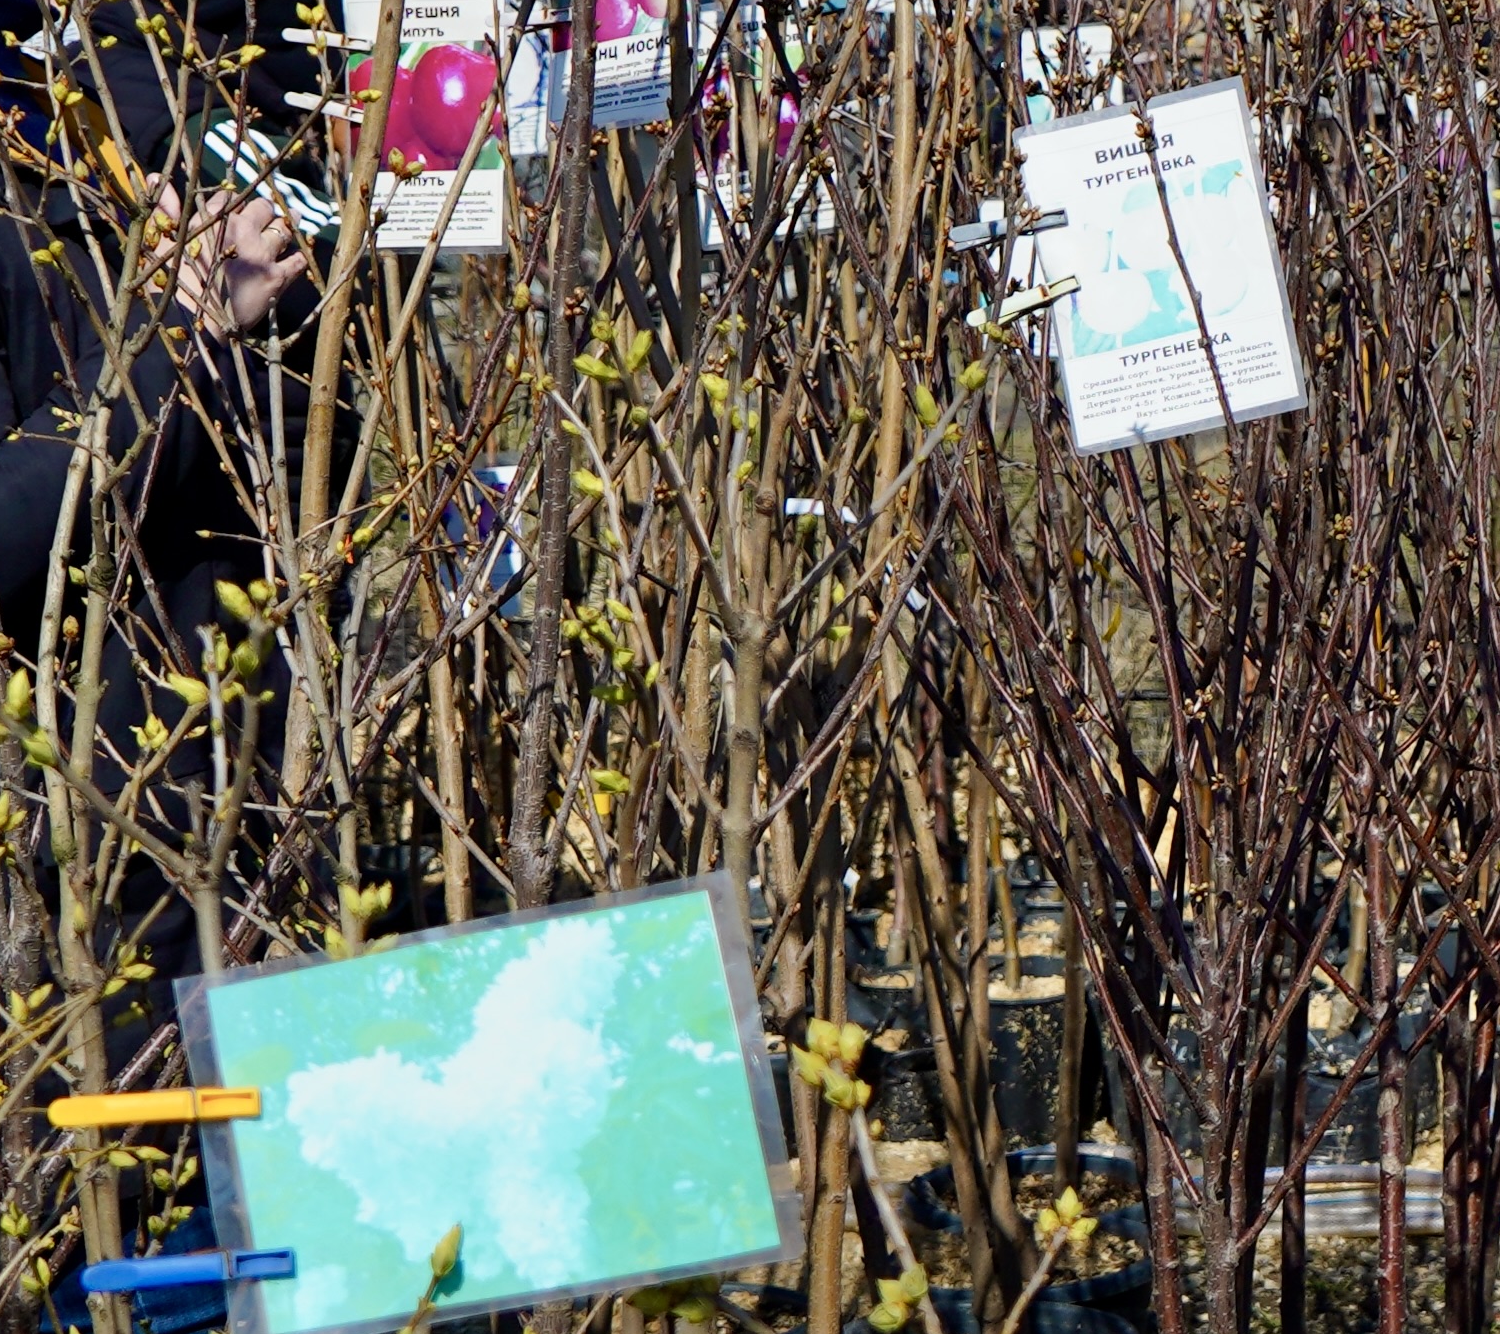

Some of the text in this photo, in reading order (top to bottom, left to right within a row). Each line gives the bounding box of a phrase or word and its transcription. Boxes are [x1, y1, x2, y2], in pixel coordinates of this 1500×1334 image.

[405, 6, 460, 18] РЕШНЯ
[402, 27, 444, 38] ИПУТЬ
[1095, 133, 1174, 164] ВИШЯ
[405, 176, 445, 186] ИПУТЬ
[1083, 155, 1195, 189] ТУРГЕНВКА
[1083, 375, 1125, 389] Средний
[1155, 358, 1198, 373] Высокая
[1086, 396, 1121, 410] Дерево
[1160, 381, 1196, 394] рослое,
[1232, 361, 1278, 377] крупные,
[1120, 405, 1133, 413] до
[1164, 387, 1202, 402] Кожица
[1136, 409, 1159, 419] Вкус
